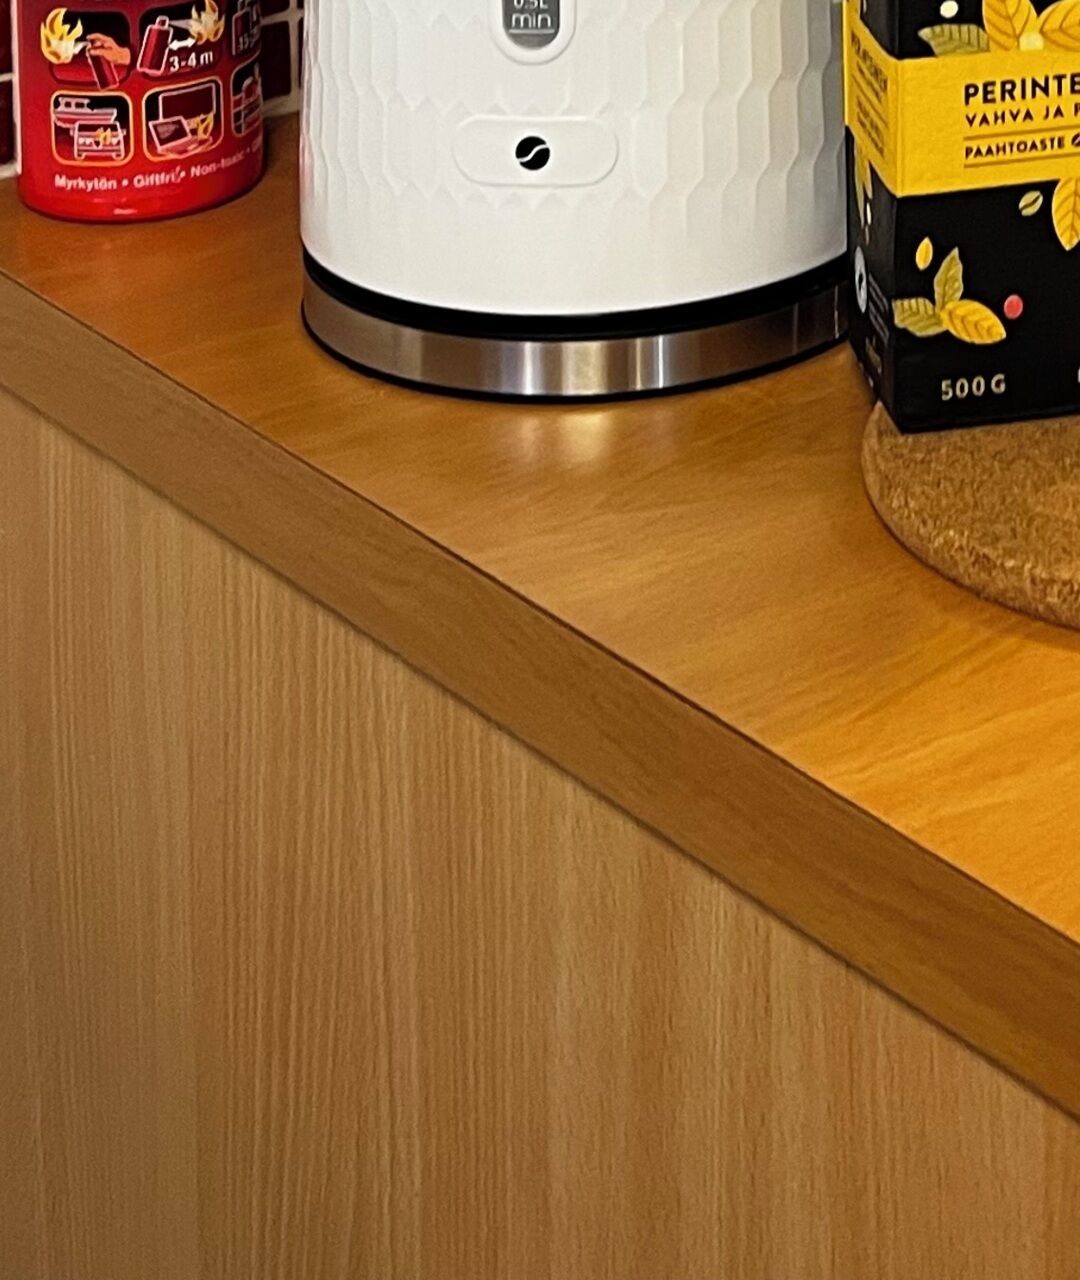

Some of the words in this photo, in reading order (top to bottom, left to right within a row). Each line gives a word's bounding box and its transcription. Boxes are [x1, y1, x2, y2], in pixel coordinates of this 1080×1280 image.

[511, 11, 551, 28] min
[169, 55, 197, 72] 3-4
[199, 51, 214, 65] m
[965, 108, 1034, 128] VAHVA
[1043, 104, 1065, 121] JA
[965, 136, 1065, 160] PAAHTOASTE
[941, 376, 986, 401] 500
[991, 374, 1006, 395] G
